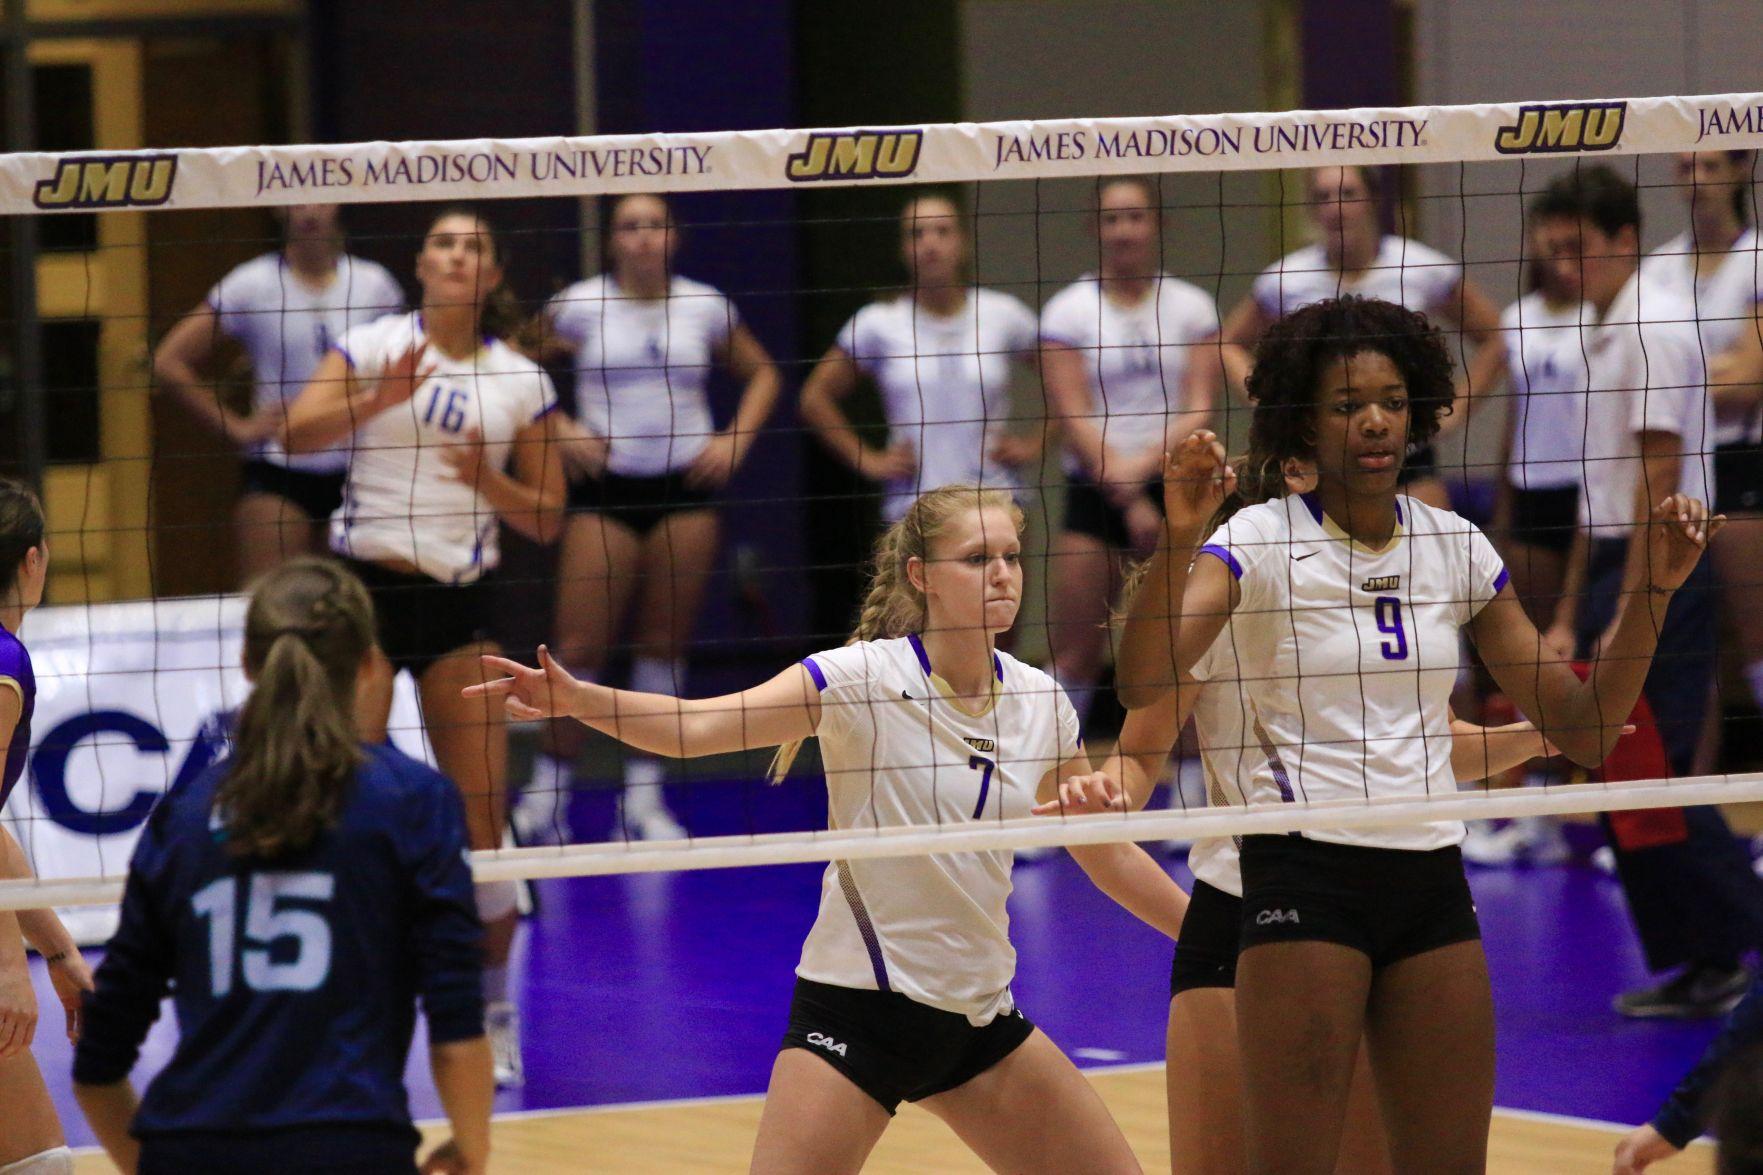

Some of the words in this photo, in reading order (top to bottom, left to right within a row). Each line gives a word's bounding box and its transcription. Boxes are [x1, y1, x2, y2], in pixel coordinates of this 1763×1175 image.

[994, 132, 1085, 172] JAMES
[1094, 126, 1243, 159] MADISON
[1252, 119, 1428, 153] UNIVERSITY
[1495, 101, 1627, 154] JMU
[34, 154, 179, 208] JMU
[255, 158, 353, 197] JAMES
[363, 152, 518, 186] MADISON
[530, 145, 713, 181] UNIVERSITY
[786, 129, 923, 181] JMU
[423, 385, 468, 434] 16
[1361, 575, 1400, 592] JMU
[1375, 596, 1408, 660] 9
[969, 755, 995, 820] 7
[191, 872, 335, 998] 15
[1256, 909, 1300, 925] CAA
[807, 1032, 848, 1057] CAA
